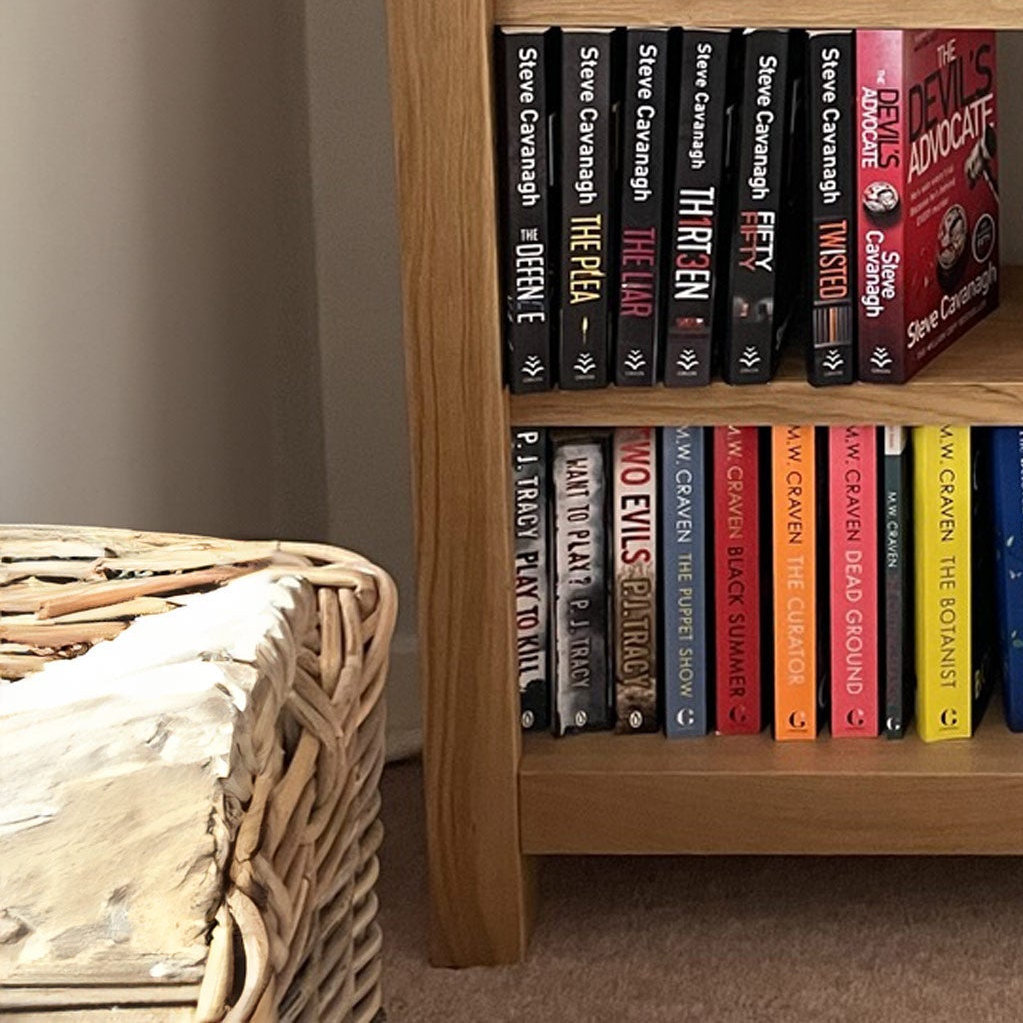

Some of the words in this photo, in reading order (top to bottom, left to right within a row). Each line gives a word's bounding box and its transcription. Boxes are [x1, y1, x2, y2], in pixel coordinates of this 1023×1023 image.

[519, 47, 538, 103] Steve
[580, 47, 599, 102] Steve
[637, 44, 658, 100] Steve
[695, 43, 712, 88] Steve
[757, 56, 778, 107] Steve
[821, 48, 840, 103] Steve
[937, 39, 957, 68] THE
[908, 43, 992, 142] DEVIL'S
[517, 109, 541, 206] Cavanagh
[575, 108, 598, 204] Cavanagh
[630, 105, 656, 201] Cavanagh
[688, 92, 710, 169] Cavanagh
[748, 110, 775, 200] Cavanagh
[819, 108, 841, 204] Cavanagh
[861, 87, 878, 169] ADVOCATE
[877, 88, 900, 169] DEVIL'S
[907, 93, 994, 184] ADVOCATE
[520, 228, 539, 242] THE
[570, 214, 602, 251] THE
[623, 228, 656, 266] THE
[739, 211, 759, 271] FIFTY
[755, 211, 776, 272] FIFTY
[819, 220, 848, 299] TWISTED
[516, 244, 545, 323] DEFENCE
[570, 256, 603, 305] PLEA
[621, 272, 654, 317] LIAR
[861, 230, 885, 318] Cavanagh
[881, 251, 901, 300] Steve
[907, 310, 939, 349] Steve
[940, 261, 997, 320] Cavanagh
[566, 457, 590, 497] WANT
[675, 470, 692, 543] CRAVEN
[727, 466, 744, 539] CRAVEN
[845, 469, 861, 542] CRAVEN
[939, 469, 955, 542] CRAVEN
[517, 475, 539, 540] TRACY
[567, 503, 590, 522] TO
[620, 494, 651, 565] EVILS
[786, 471, 803, 545] CRAVEN
[677, 553, 693, 582] THE
[786, 557, 805, 590] THE
[887, 522, 899, 568] CRAVEN
[939, 555, 956, 590] THE
[515, 551, 539, 601] PLAY
[727, 547, 745, 606] BLACK
[845, 550, 863, 602] DEAD
[517, 605, 539, 630] TO
[678, 589, 694, 641] PUPPET
[786, 596, 806, 686] CURATOR
[939, 598, 957, 689] BOTANIST
[518, 635, 539, 674] KILL
[571, 638, 591, 689] TRACY
[623, 618, 651, 689] TRACY
[679, 648, 695, 698] SHOW
[728, 613, 746, 698] SUMMER
[845, 609, 864, 695] GROUND
